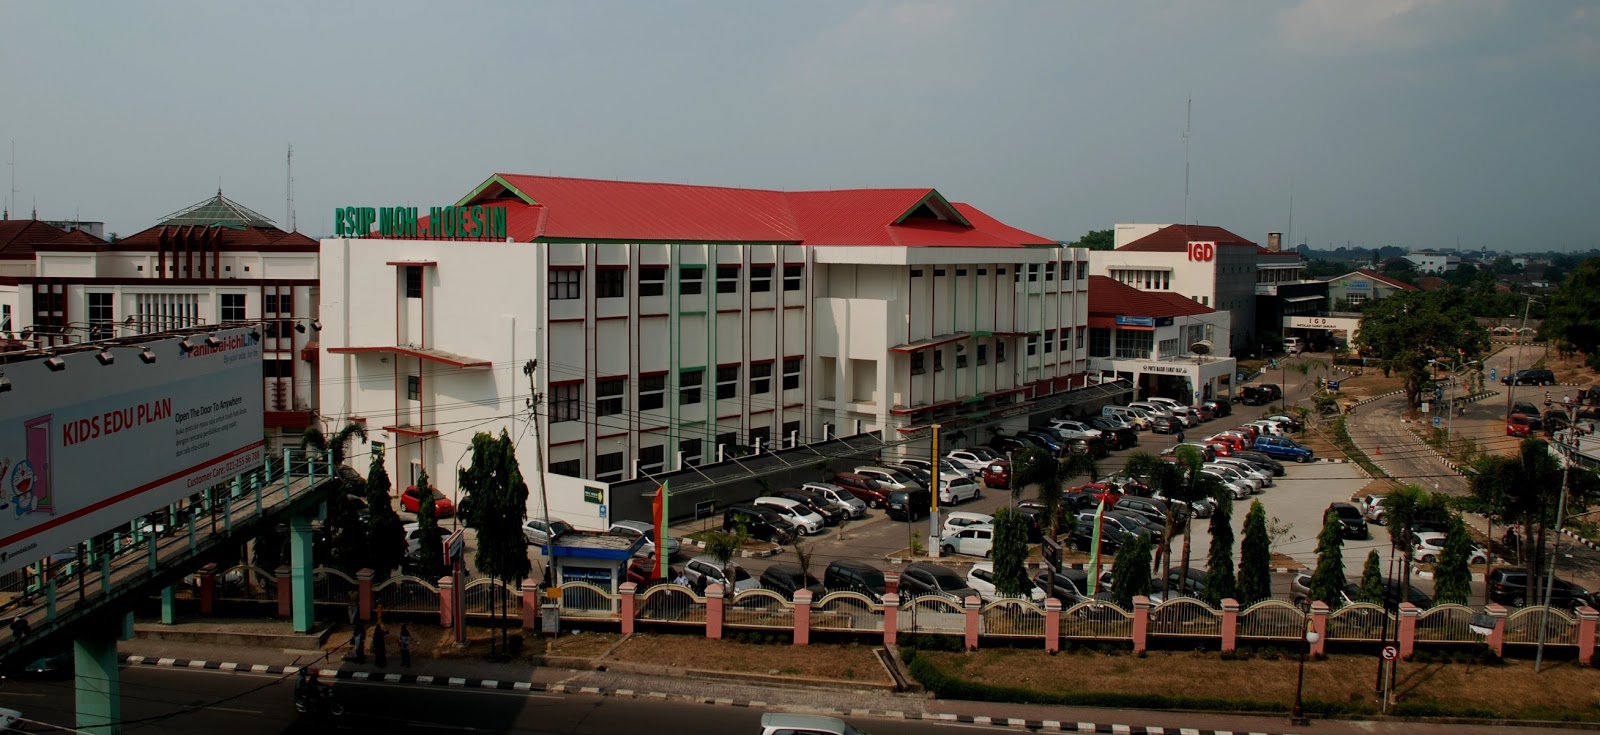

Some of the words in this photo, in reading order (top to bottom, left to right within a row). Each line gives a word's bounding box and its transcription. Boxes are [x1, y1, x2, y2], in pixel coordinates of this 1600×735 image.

[335, 206, 375, 236] RSUP
[429, 206, 507, 238] HOESIN
[1188, 243, 1214, 262] IGD
[63, 415, 100, 447] KIDS
[103, 407, 134, 435] EDU
[137, 397, 172, 426] PLAN
[175, 412, 190, 424] Open
[190, 408, 200, 418] The
[200, 405, 213, 415] Door
[213, 402, 220, 412] To
[219, 396, 243, 411] Anywhere
[187, 472, 212, 488] Customer
[212, 465, 226, 478] Care:
